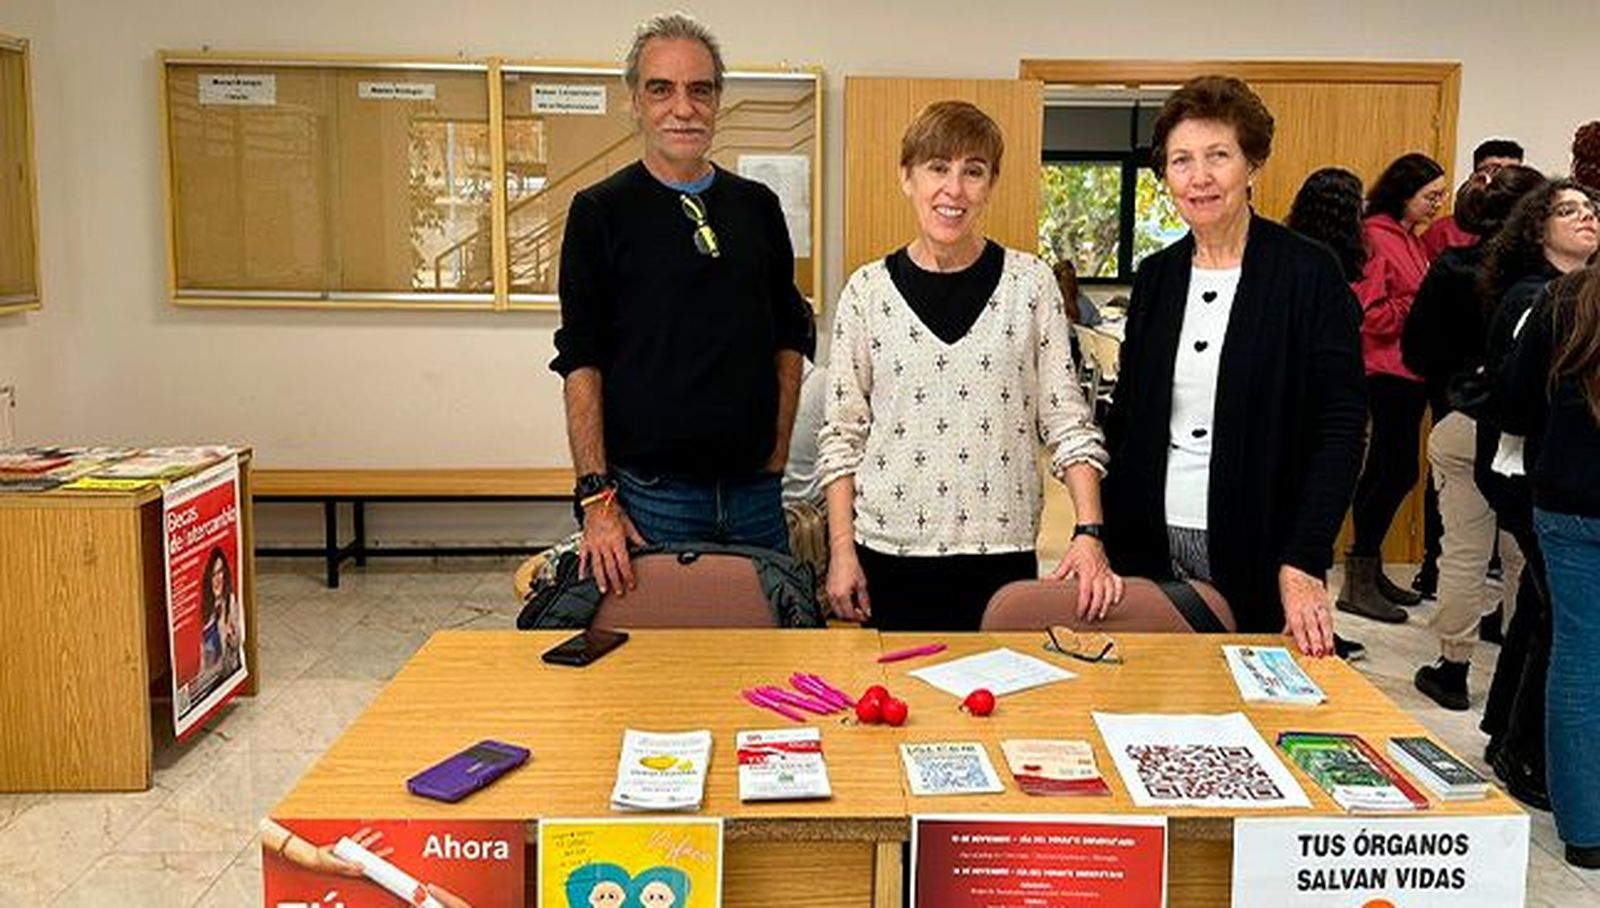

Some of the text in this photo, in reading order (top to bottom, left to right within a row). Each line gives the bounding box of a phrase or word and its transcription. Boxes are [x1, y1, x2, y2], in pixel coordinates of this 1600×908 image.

[167, 505, 199, 533] Becas
[170, 533, 184, 555] de
[423, 834, 510, 860] Ahora
[1297, 828, 1469, 857] TUS ÓRGANOS
[1297, 867, 1466, 891] SALVAN VIDAS
